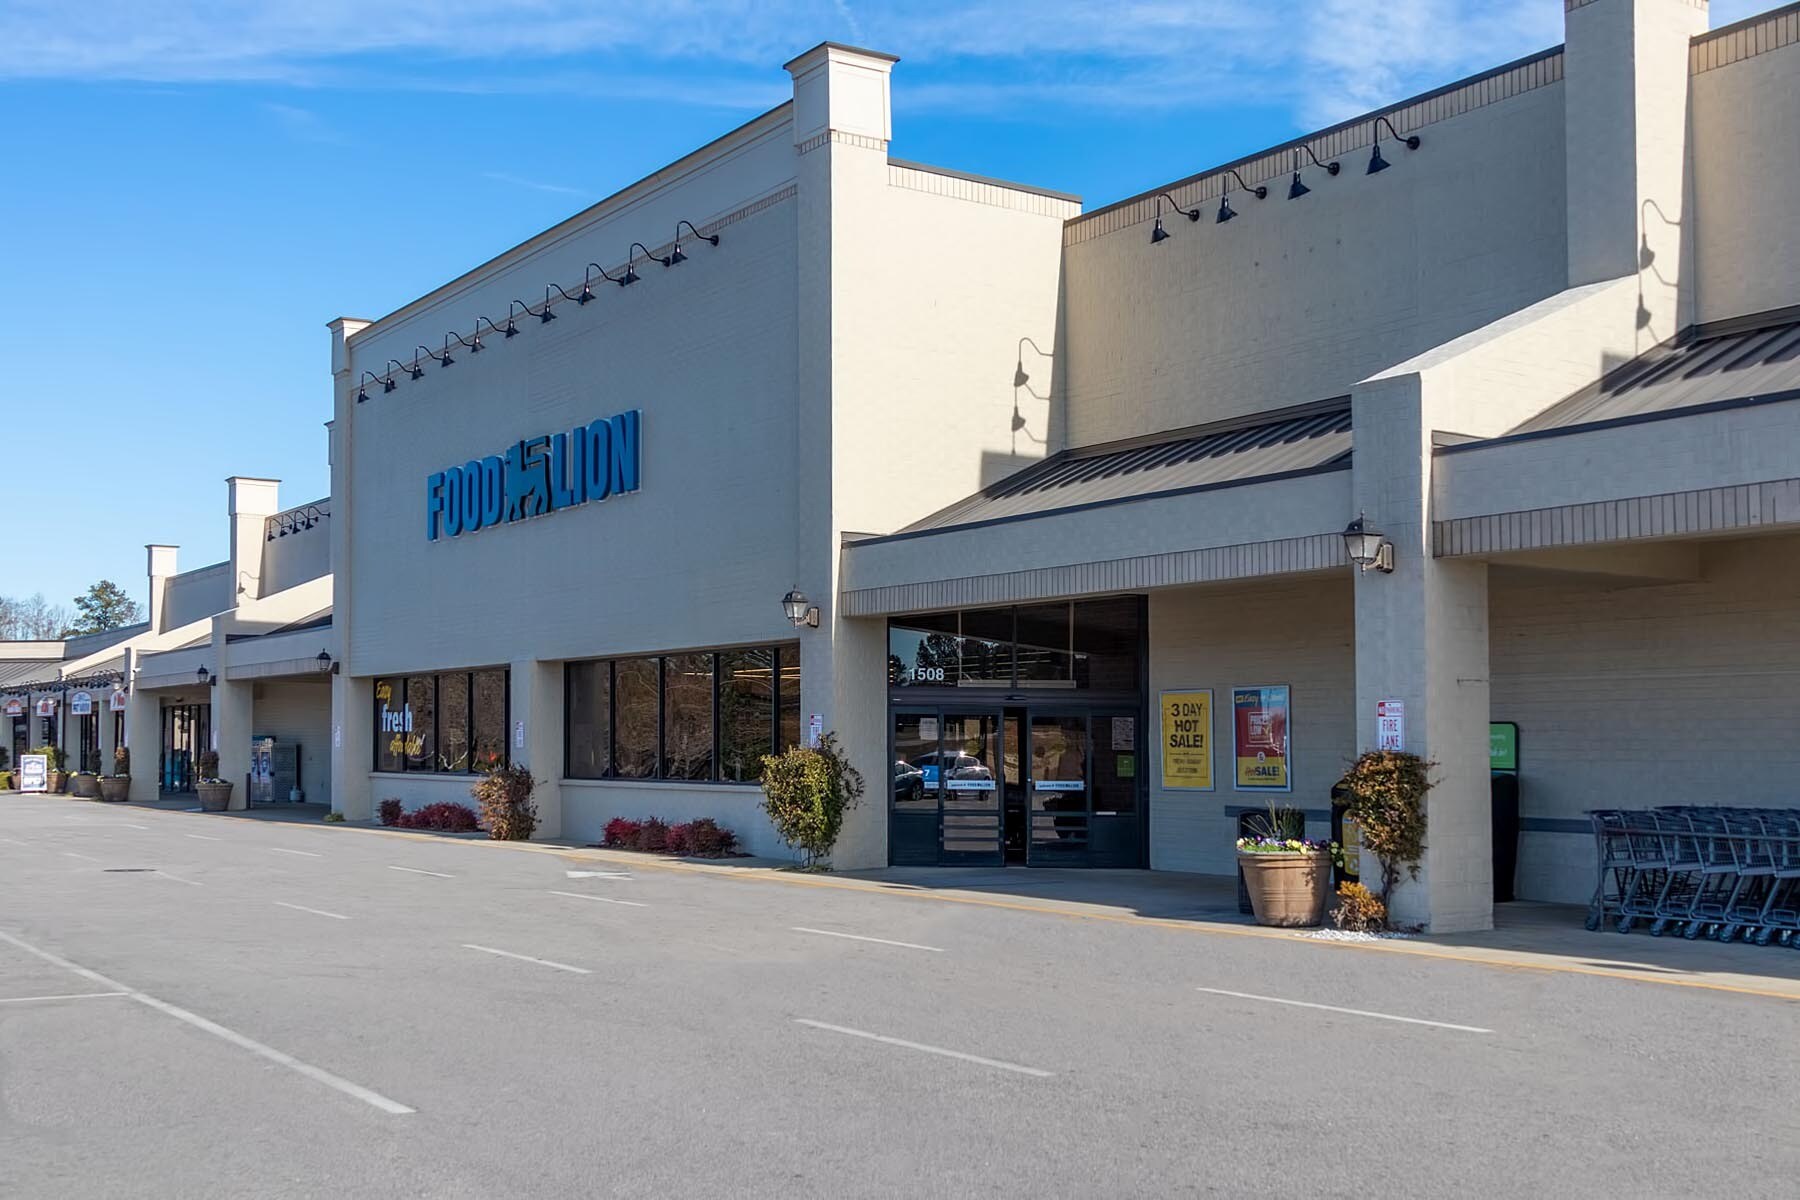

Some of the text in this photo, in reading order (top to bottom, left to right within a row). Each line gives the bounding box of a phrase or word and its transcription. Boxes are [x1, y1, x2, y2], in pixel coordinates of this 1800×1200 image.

[427, 408, 643, 542] FOOD LION
[909, 667, 945, 681] 1508
[1170, 703, 1203, 717] 3 DAY
[381, 703, 413, 732] fresh
[1173, 719, 1200, 733] HOT
[1382, 718, 1398, 732] FIRE
[1169, 733, 1204, 749] SALE!
[1381, 735, 1400, 748] LANE
